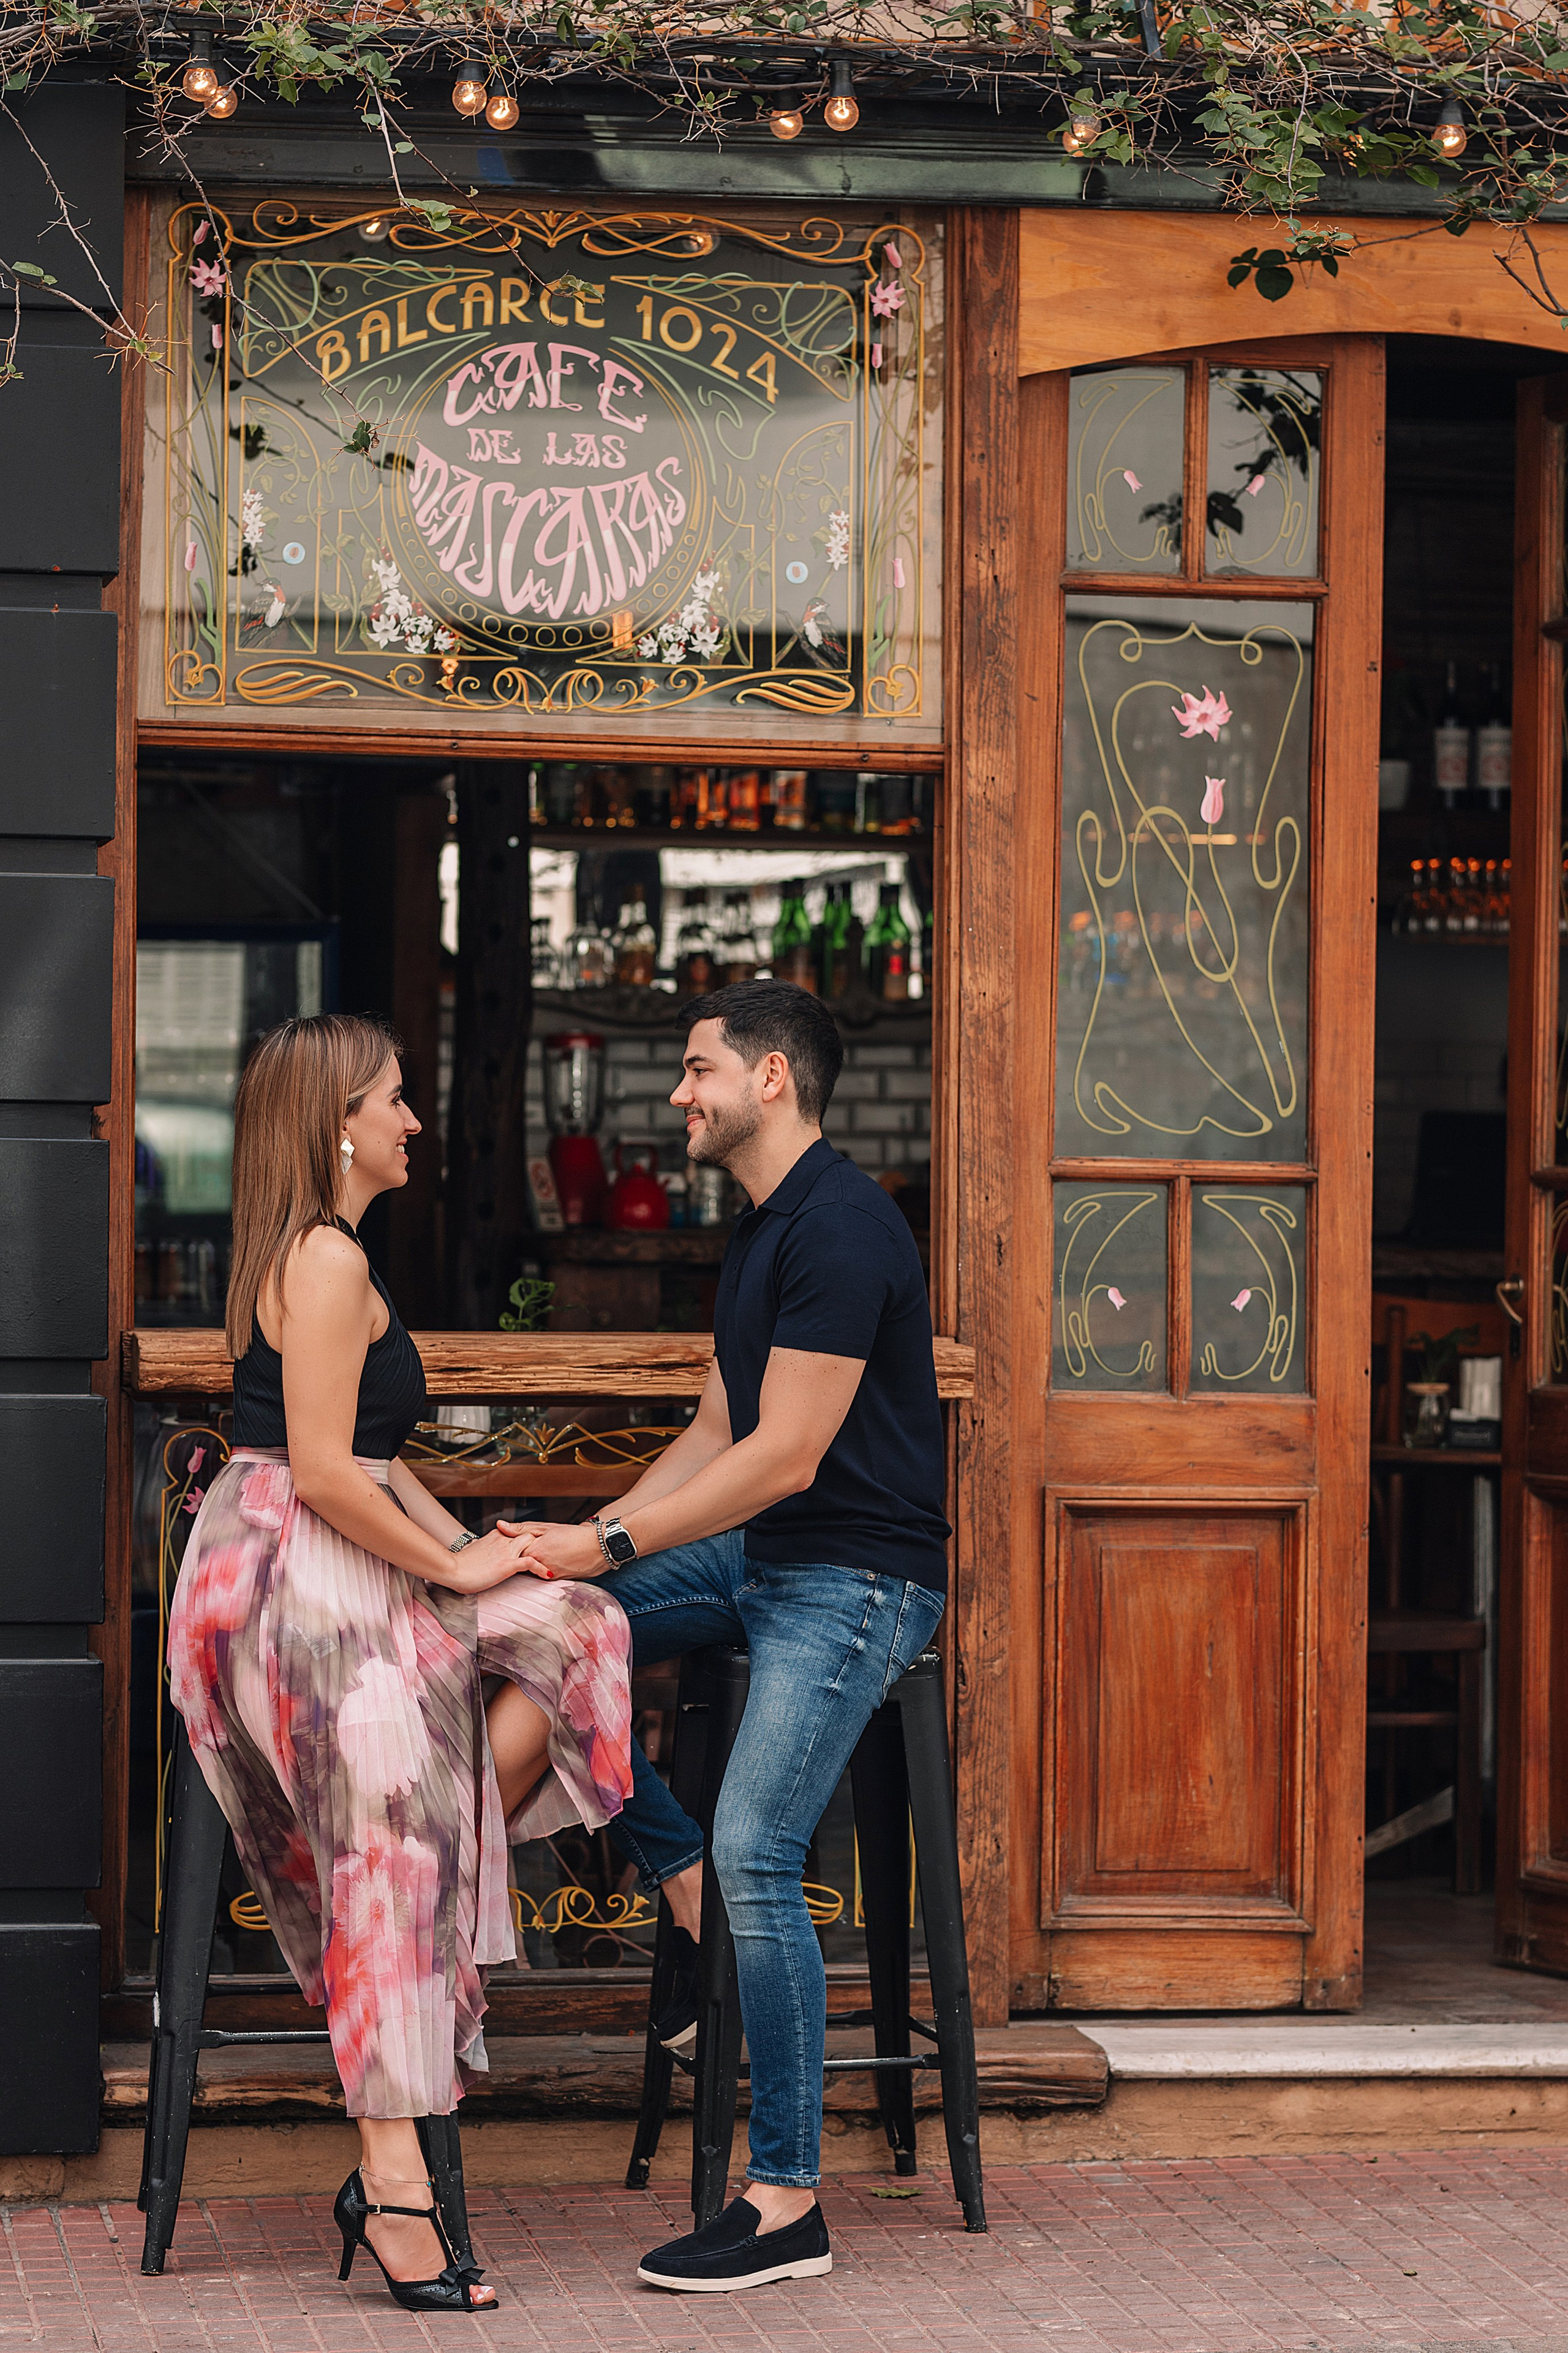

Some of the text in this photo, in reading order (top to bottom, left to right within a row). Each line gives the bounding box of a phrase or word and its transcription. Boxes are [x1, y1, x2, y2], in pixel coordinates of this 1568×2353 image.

[315, 278, 779, 404] BALCARCE 1024
[443, 342, 648, 434] CAFE
[466, 428, 628, 469] DE LAS
[409, 441, 686, 619] MASCARAS
